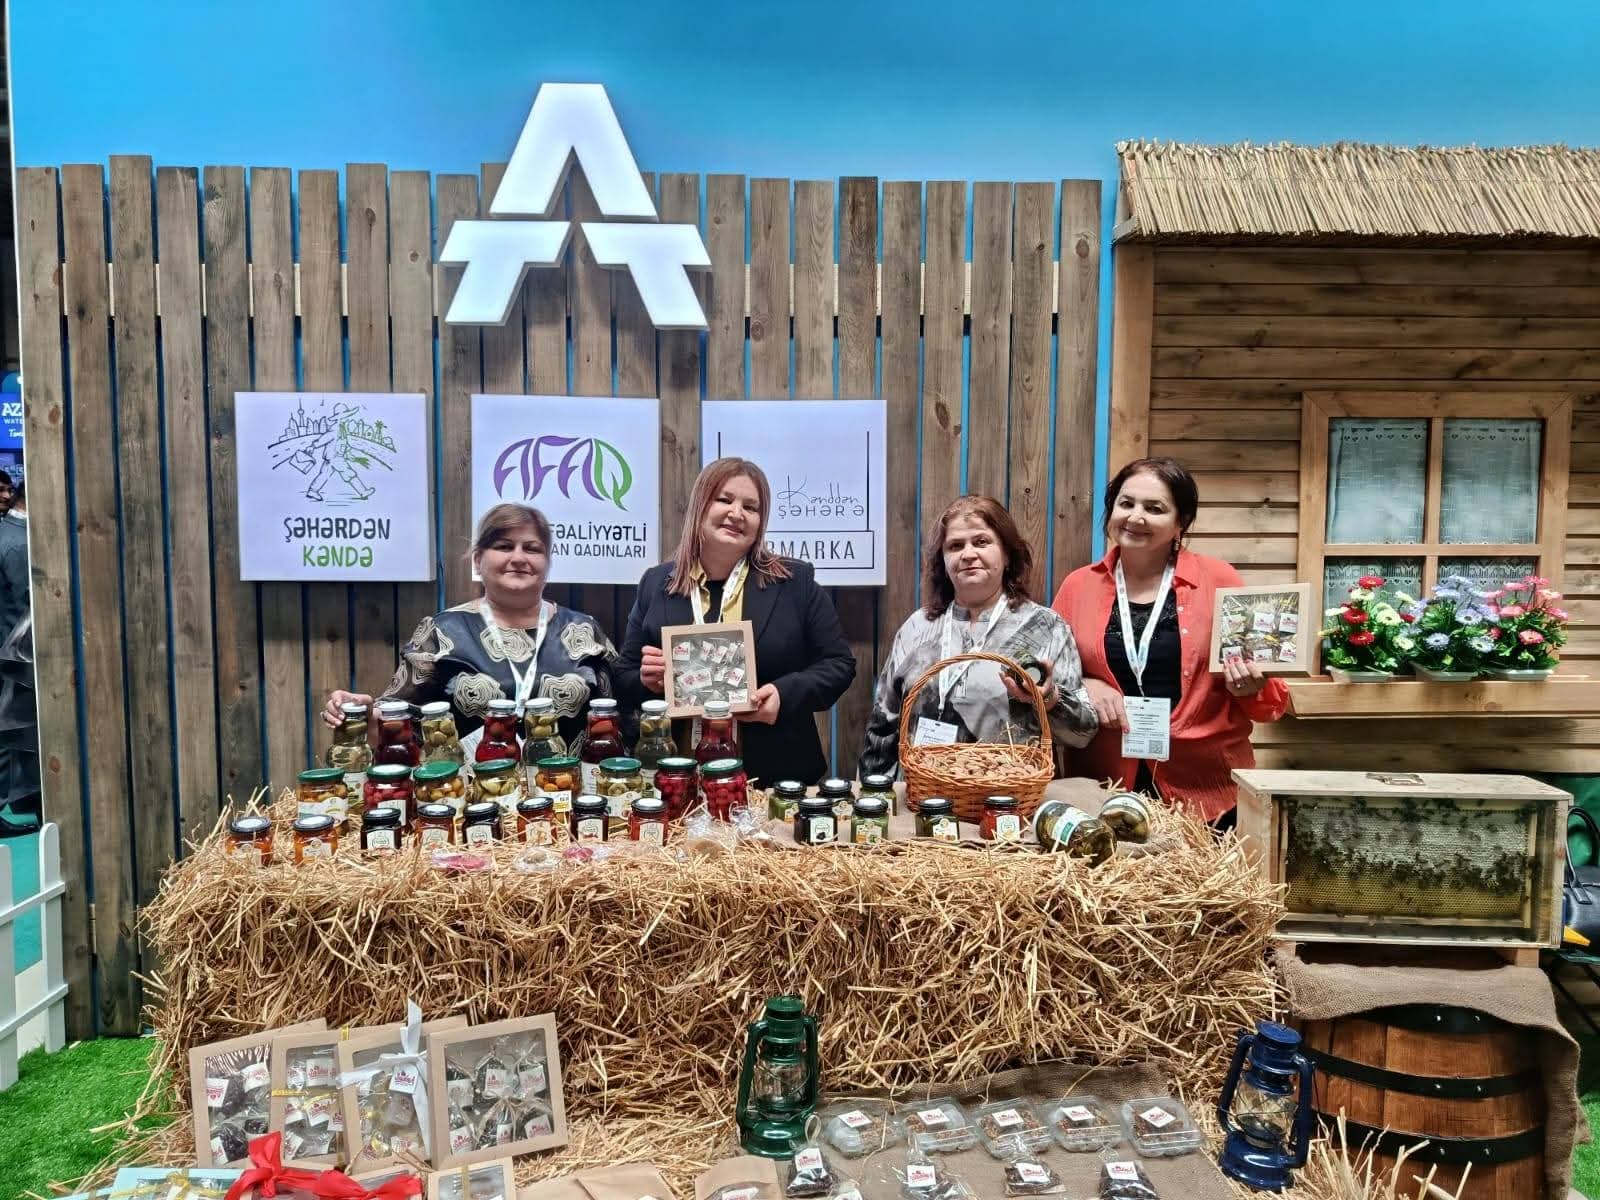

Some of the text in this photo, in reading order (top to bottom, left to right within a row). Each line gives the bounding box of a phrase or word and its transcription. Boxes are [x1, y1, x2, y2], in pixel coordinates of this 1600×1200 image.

[493, 435, 633, 512] AFAQ
[778, 505, 865, 520] ŞƏHƏRƏ
[283, 517, 391, 543] ŞƏHƏRDƏN
[303, 545, 373, 567] KƏNDƏ
[574, 543, 646, 558] QADINLARI
